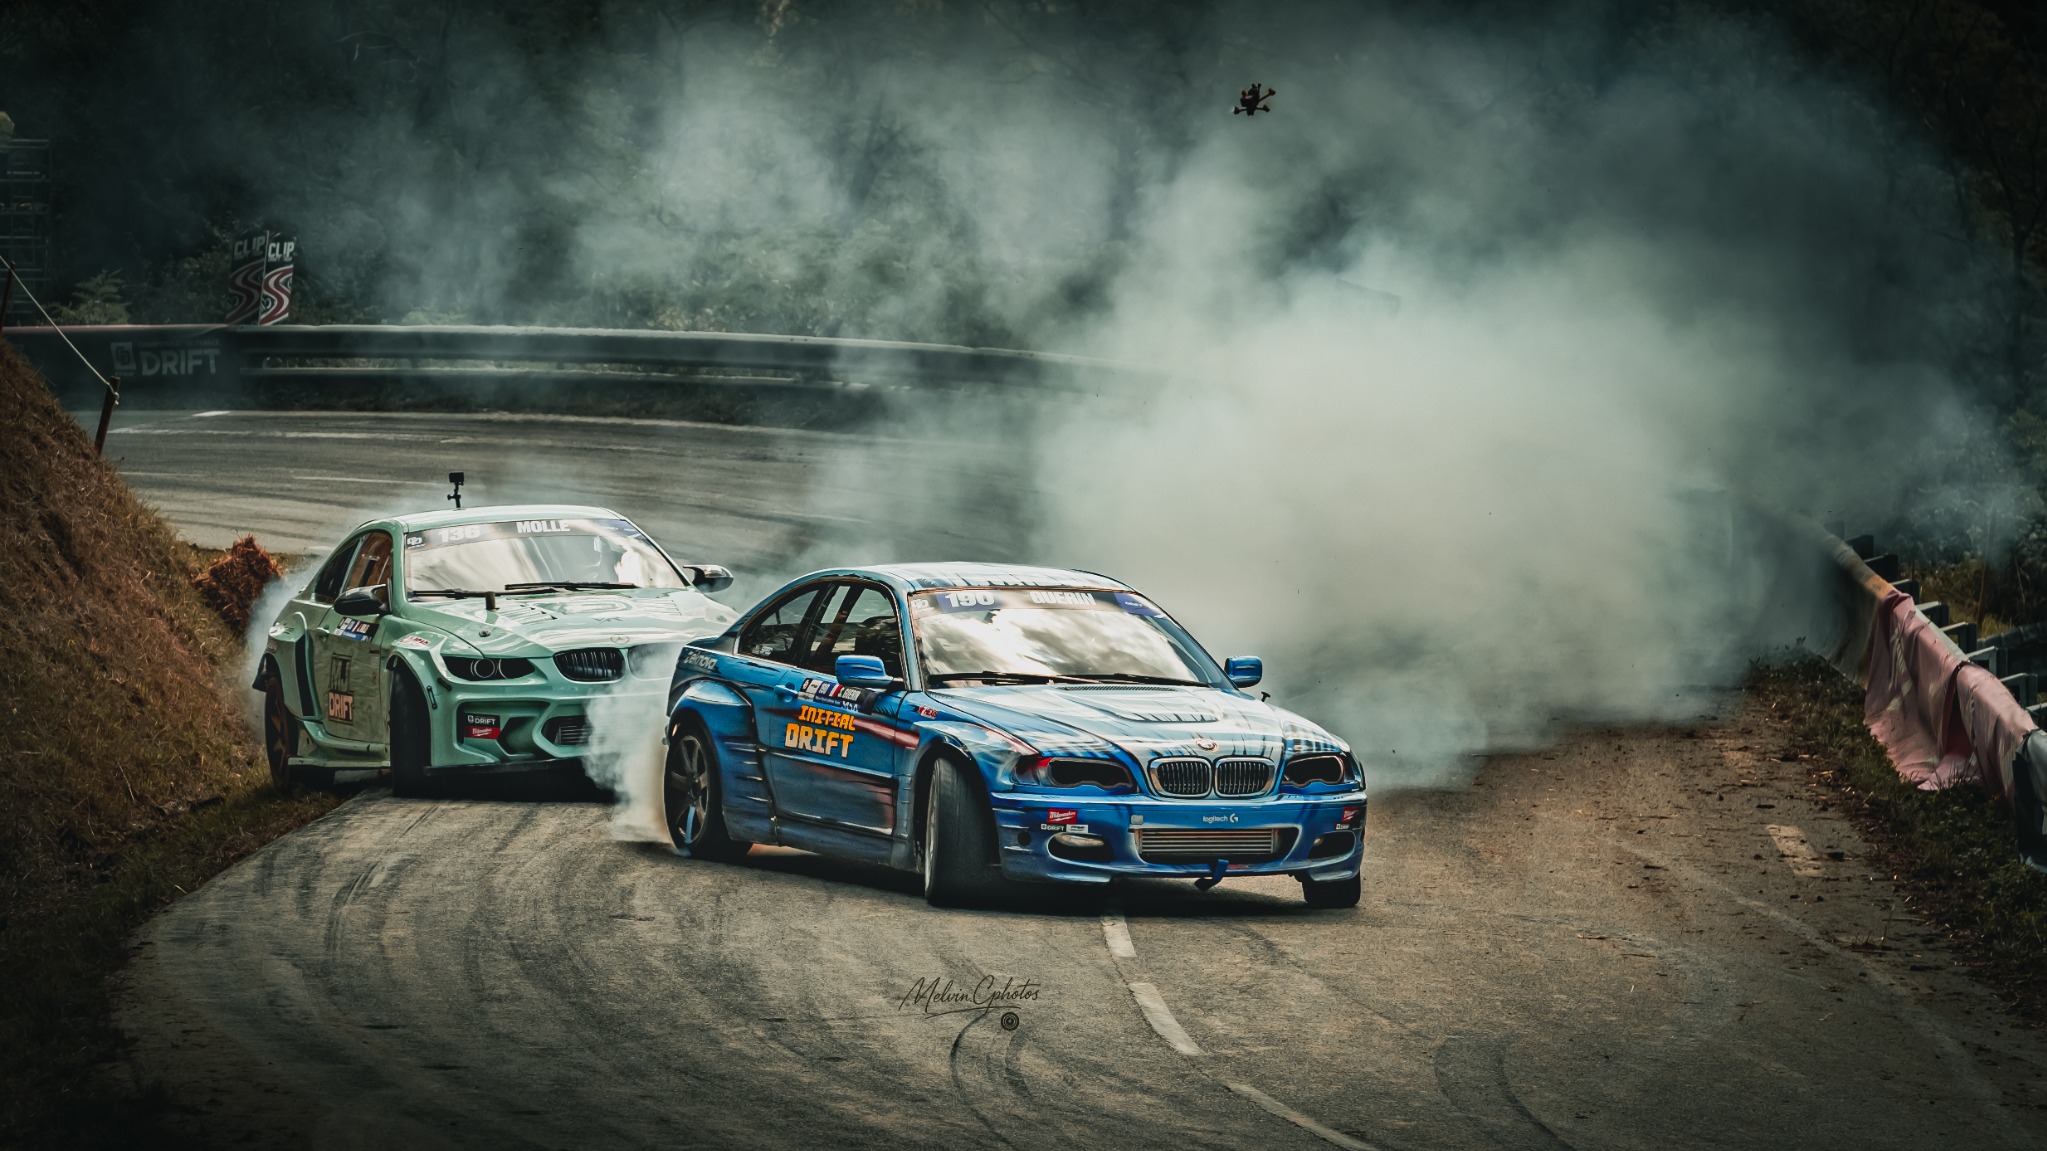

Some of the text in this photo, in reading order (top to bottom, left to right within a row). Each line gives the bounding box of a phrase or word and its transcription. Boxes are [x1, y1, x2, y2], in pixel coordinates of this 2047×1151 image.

[234, 236, 266, 257] CLIP
[268, 241, 295, 259] CLIP
[140, 348, 221, 376] DRIFT
[438, 520, 570, 543] 136 MOLLE
[945, 591, 1096, 608] 190 GUERIN
[328, 692, 354, 722] DRIFT
[798, 705, 855, 731] INITIAL
[475, 717, 496, 725] DRIFT
[784, 723, 854, 758] DRIFT
[1202, 815, 1228, 824] logitech
